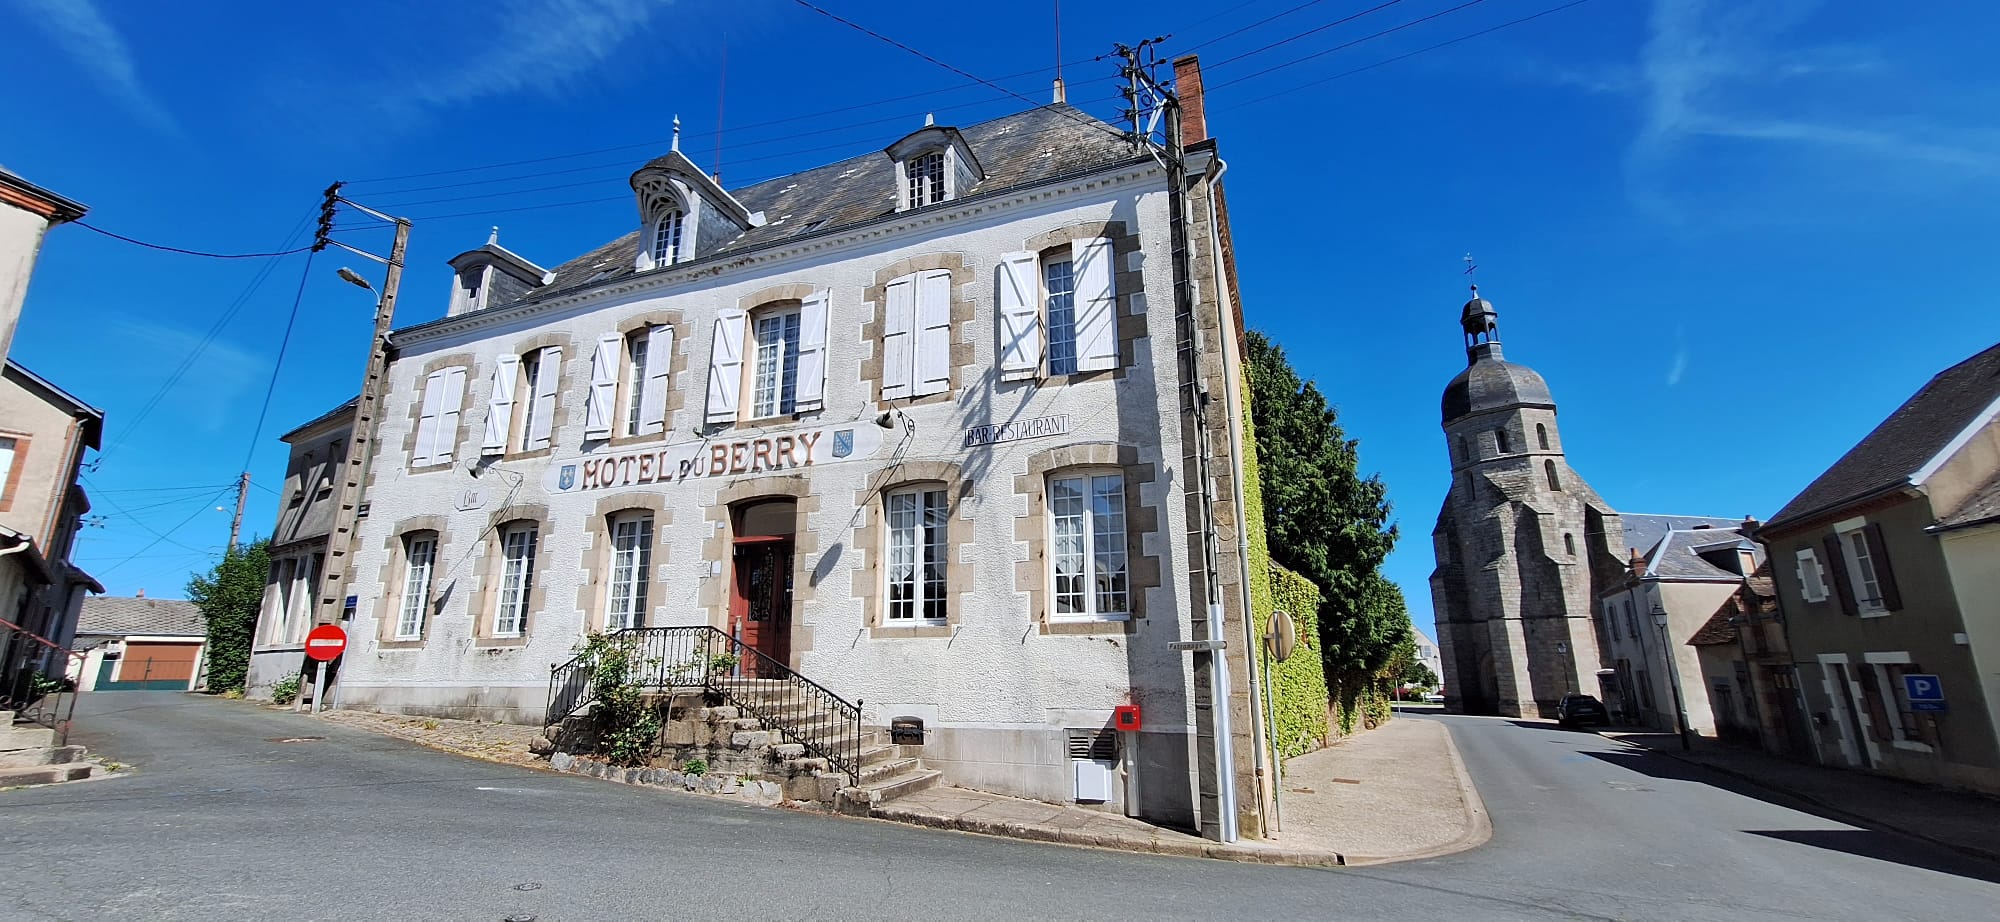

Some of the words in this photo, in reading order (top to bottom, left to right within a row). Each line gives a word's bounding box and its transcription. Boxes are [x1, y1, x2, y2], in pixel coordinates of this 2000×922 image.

[967, 428, 989, 446] BAR
[992, 415, 1067, 442] RESTAURANT
[581, 450, 674, 490] HOTEL
[678, 456, 706, 478] DU
[710, 431, 823, 477] BERRY
[1914, 679, 1931, 695] P
